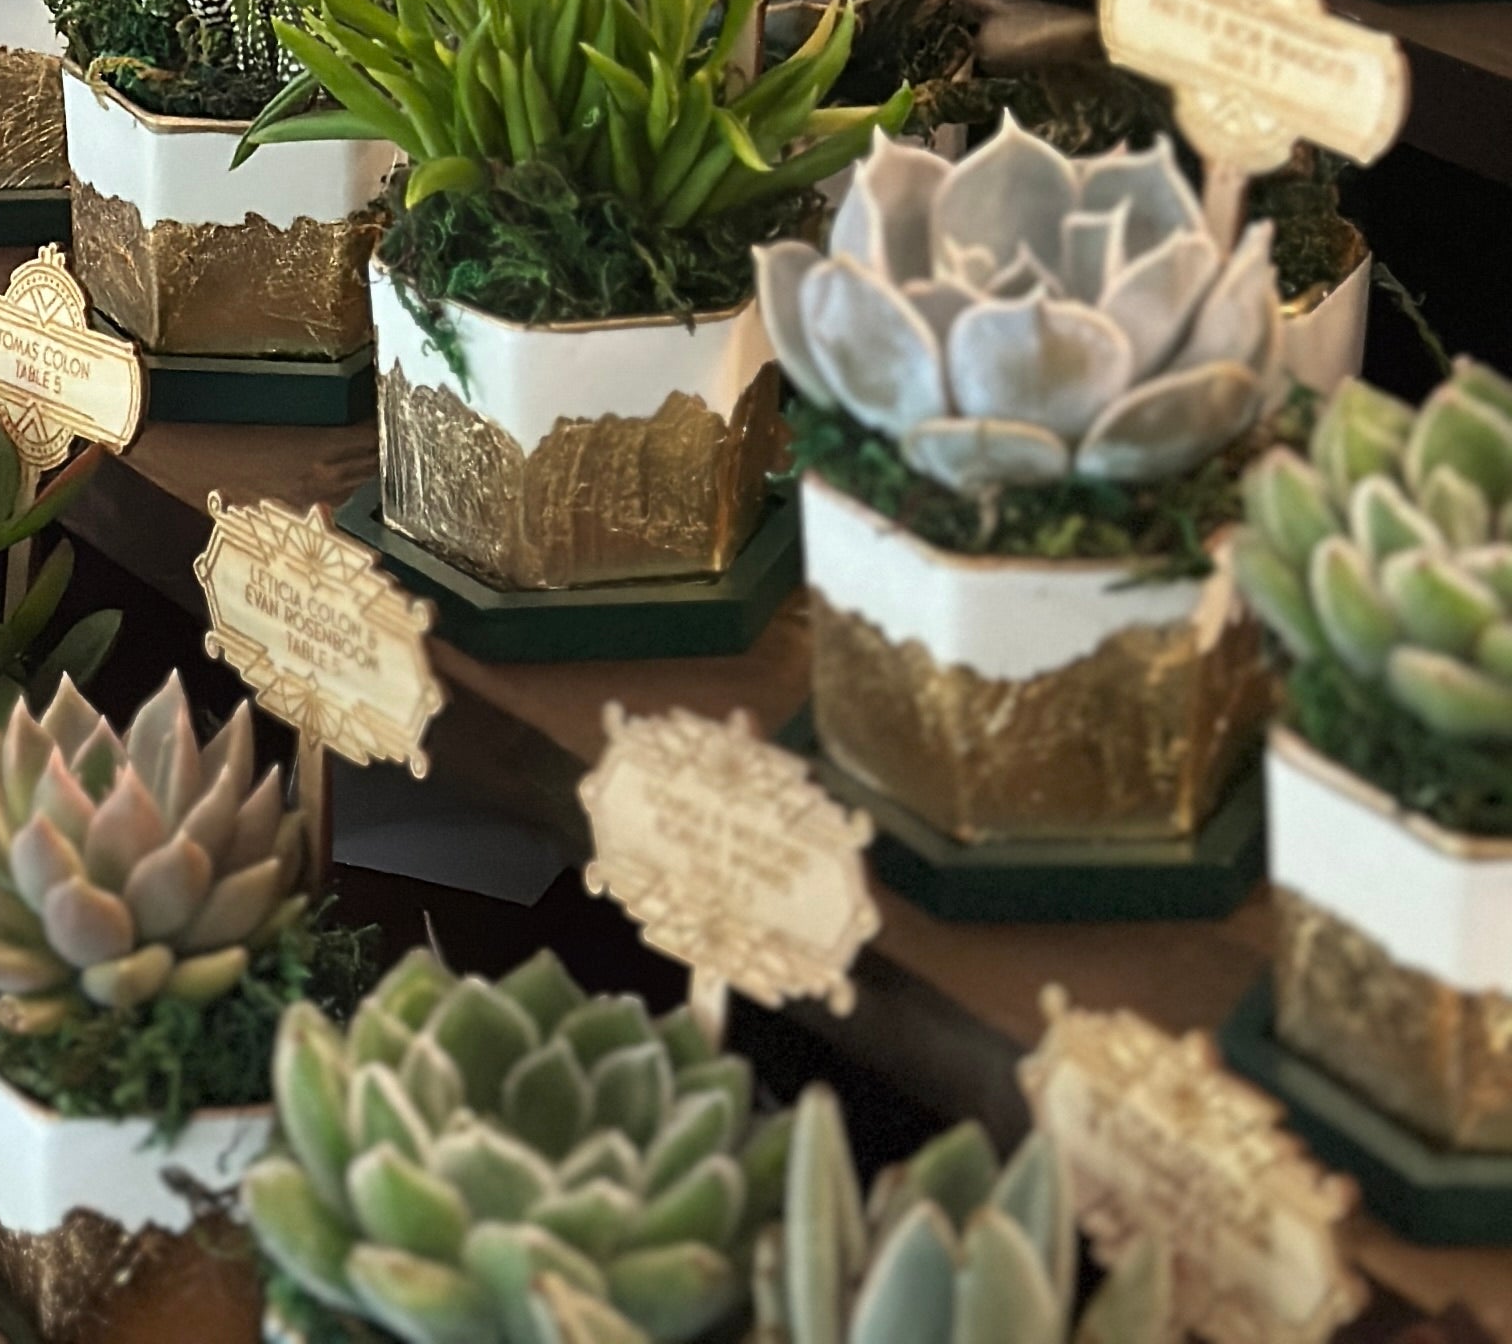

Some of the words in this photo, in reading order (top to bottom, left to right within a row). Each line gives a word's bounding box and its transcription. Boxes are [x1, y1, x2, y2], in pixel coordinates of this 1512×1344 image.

[15, 359, 50, 390] TABLE
[53, 375, 62, 395] 5
[43, 345, 91, 380] COLON
[250, 563, 302, 609] LETICIA
[306, 596, 362, 639] COLON
[244, 583, 280, 618] EVAN
[284, 605, 380, 673] ROSENBOOM
[287, 629, 329, 670] TABLE
